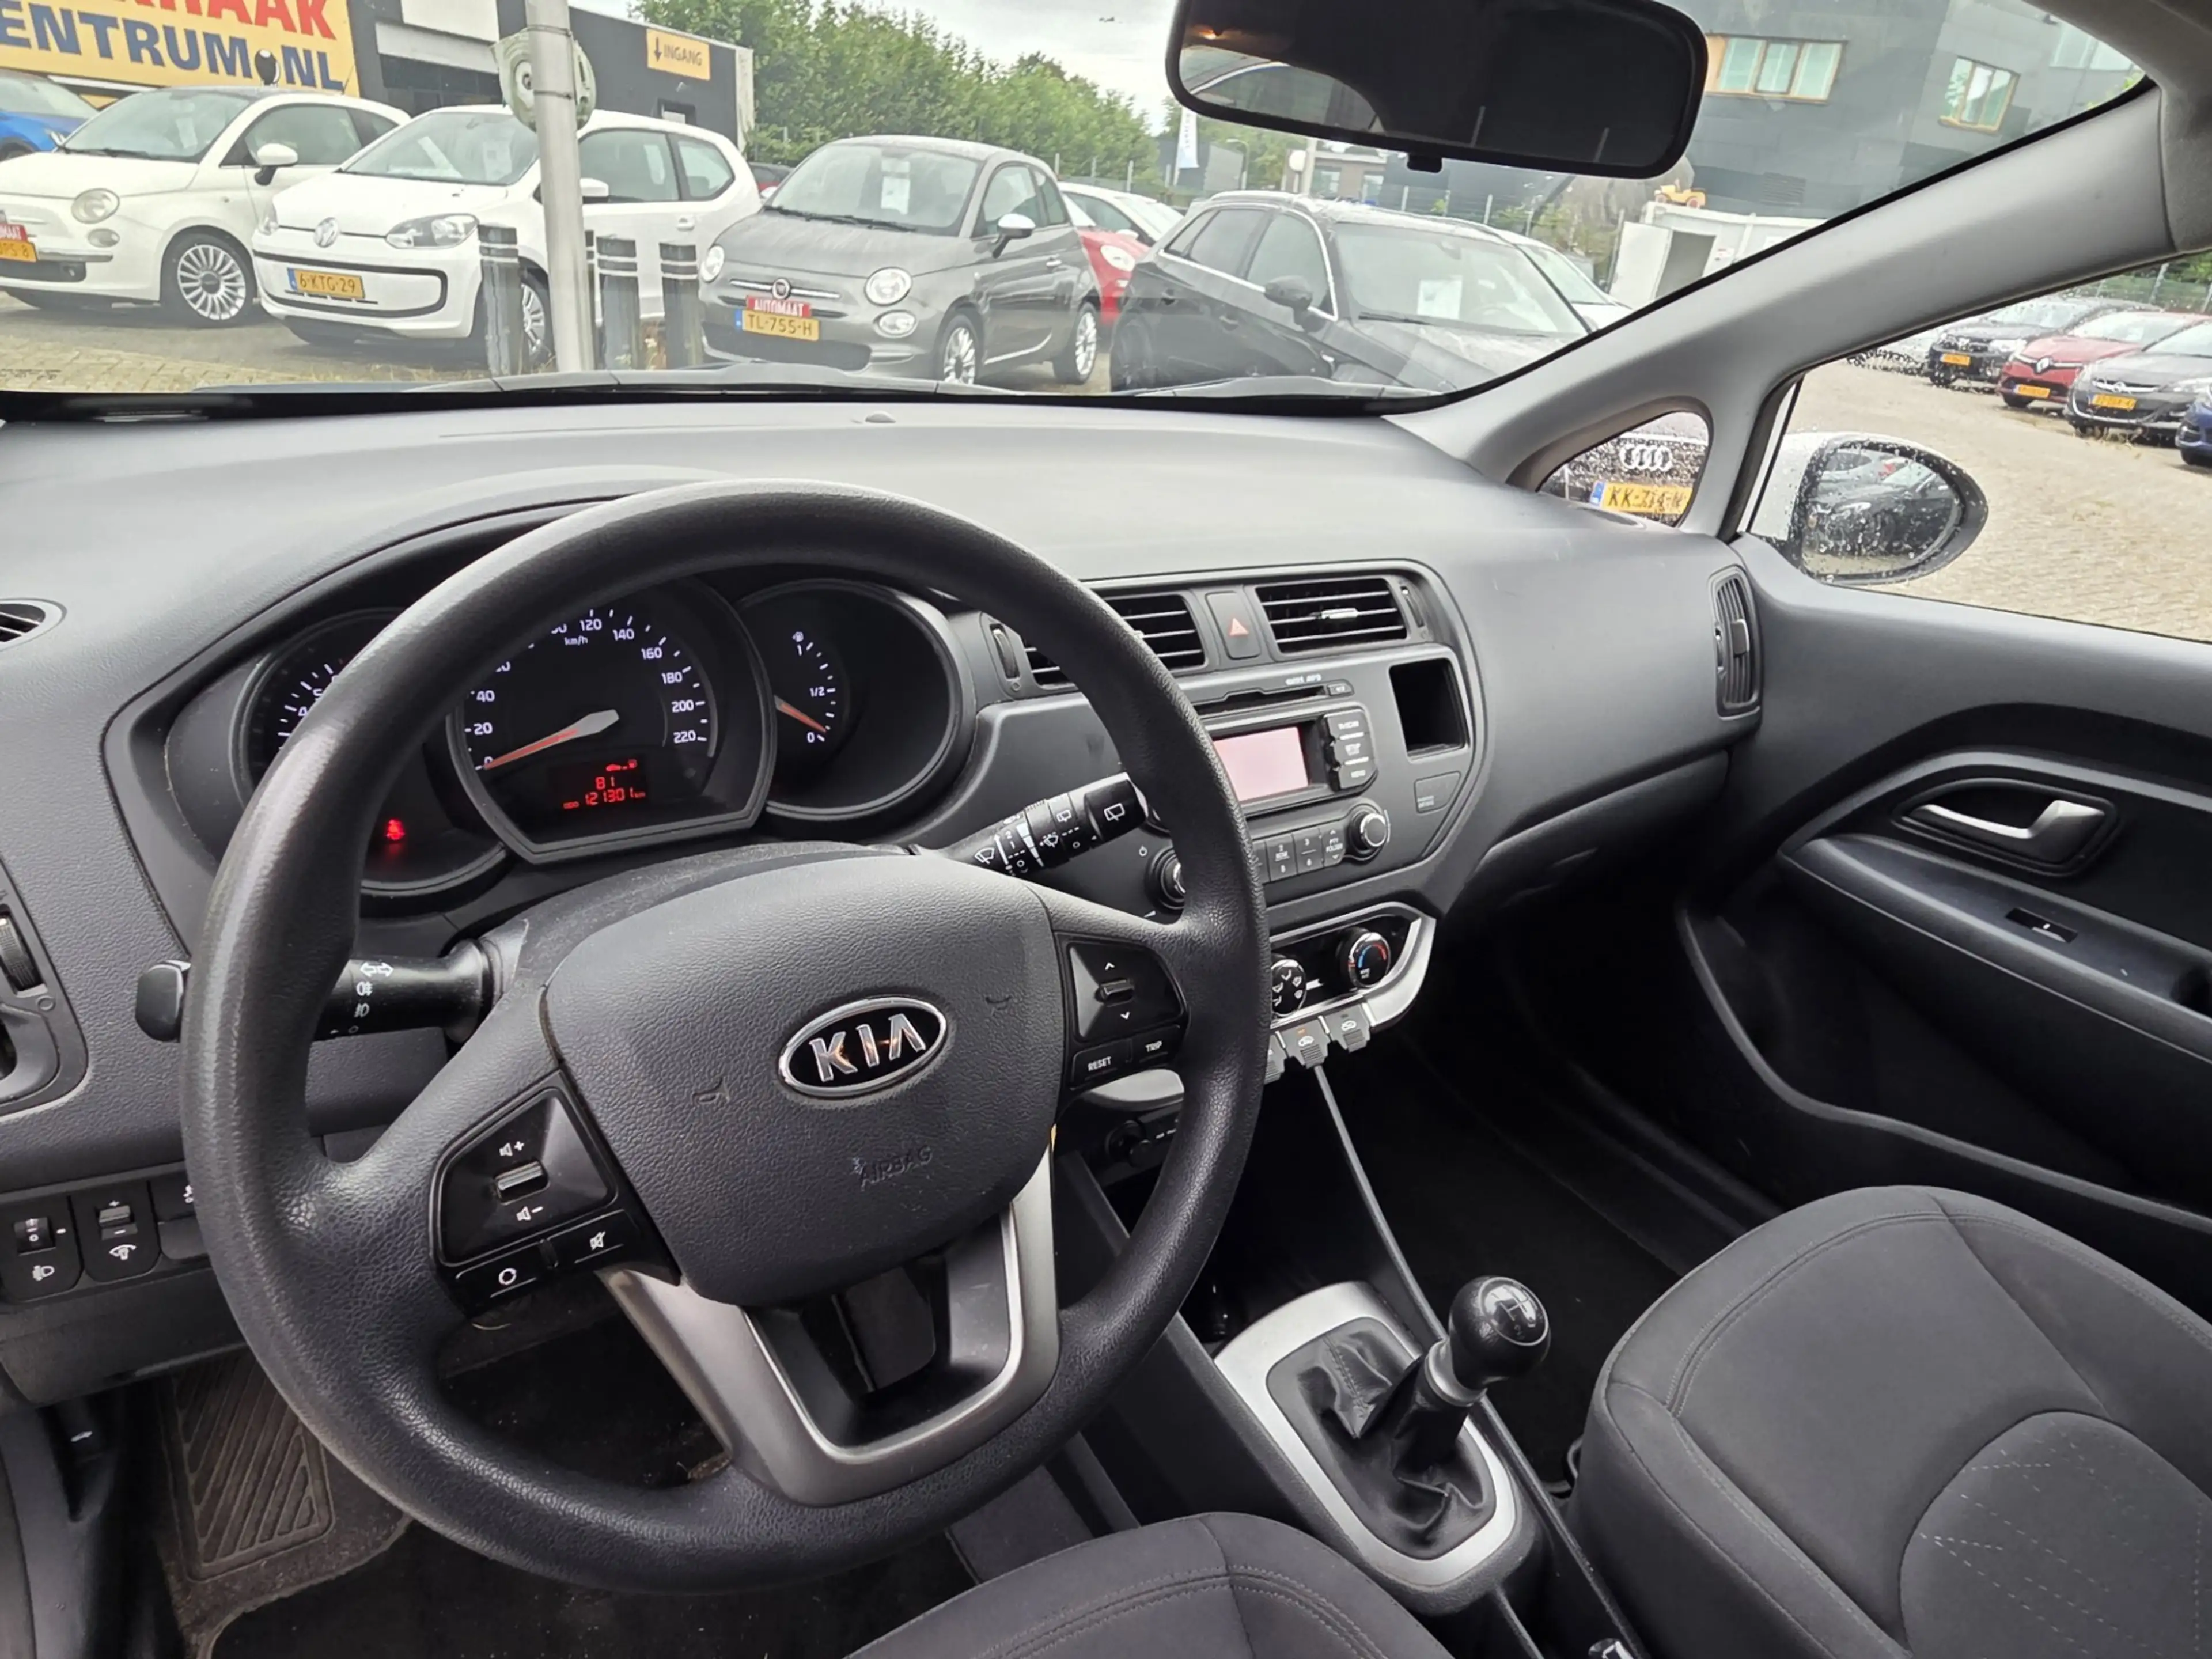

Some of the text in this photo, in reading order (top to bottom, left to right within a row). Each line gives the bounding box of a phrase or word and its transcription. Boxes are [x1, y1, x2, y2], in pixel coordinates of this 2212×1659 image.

[664, 44, 702, 66] INGANG
[755, 298, 804, 316] AUTOMAAT
[748, 313, 812, 335] TL-755-H
[580, 618, 602, 631] 120
[564, 635, 588, 646] km/h
[612, 628, 635, 641] 140
[641, 647, 662, 660] 160
[661, 671, 683, 684] 180
[476, 690, 495, 702] 40
[810, 687, 825, 697] 1/2
[672, 699, 694, 713] 200
[474, 722, 493, 735] 20
[673, 730, 696, 744] 220
[807, 732, 815, 743] 0
[585, 787, 633, 805] 121301
[809, 1013, 926, 1083] KIA
[1145, 1041, 1162, 1052] TRIP
[1088, 1056, 1112, 1071] RESET
